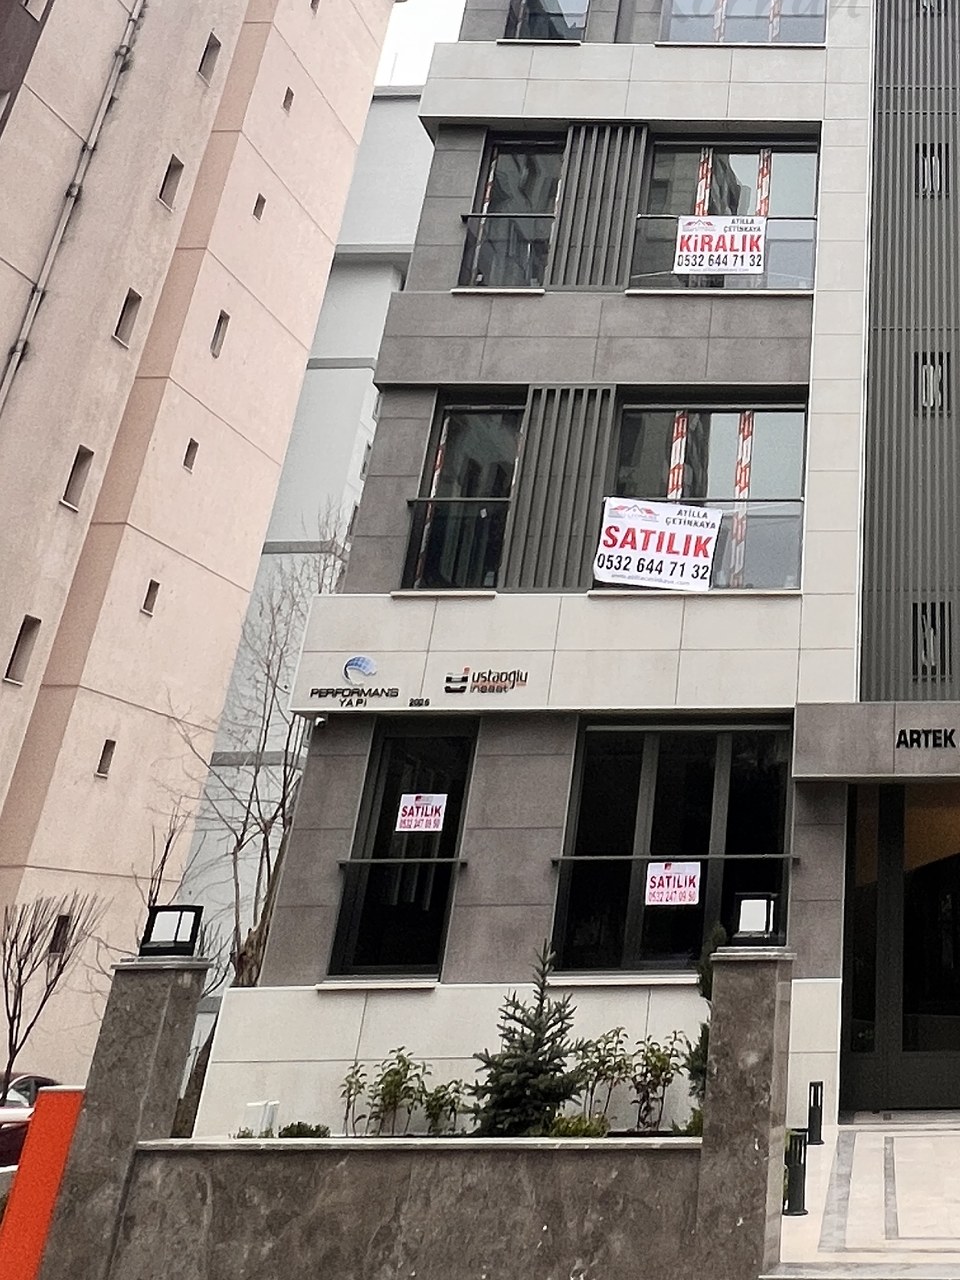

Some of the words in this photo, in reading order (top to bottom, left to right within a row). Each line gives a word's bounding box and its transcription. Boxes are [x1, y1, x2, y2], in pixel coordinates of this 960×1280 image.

[677, 254, 705, 266] 0532
[708, 254, 728, 266] 644
[732, 254, 744, 266] 71
[749, 254, 762, 266] 32
[602, 524, 713, 558] SATILIK
[597, 553, 632, 571] 0532
[636, 557, 664, 575] 644
[669, 561, 686, 577] 71
[691, 564, 710, 580] 32
[309, 687, 399, 698] PERFORMANS
[896, 728, 956, 749] ARTEK
[401, 805, 442, 818] SATILIK
[649, 875, 697, 889] SATILIK
